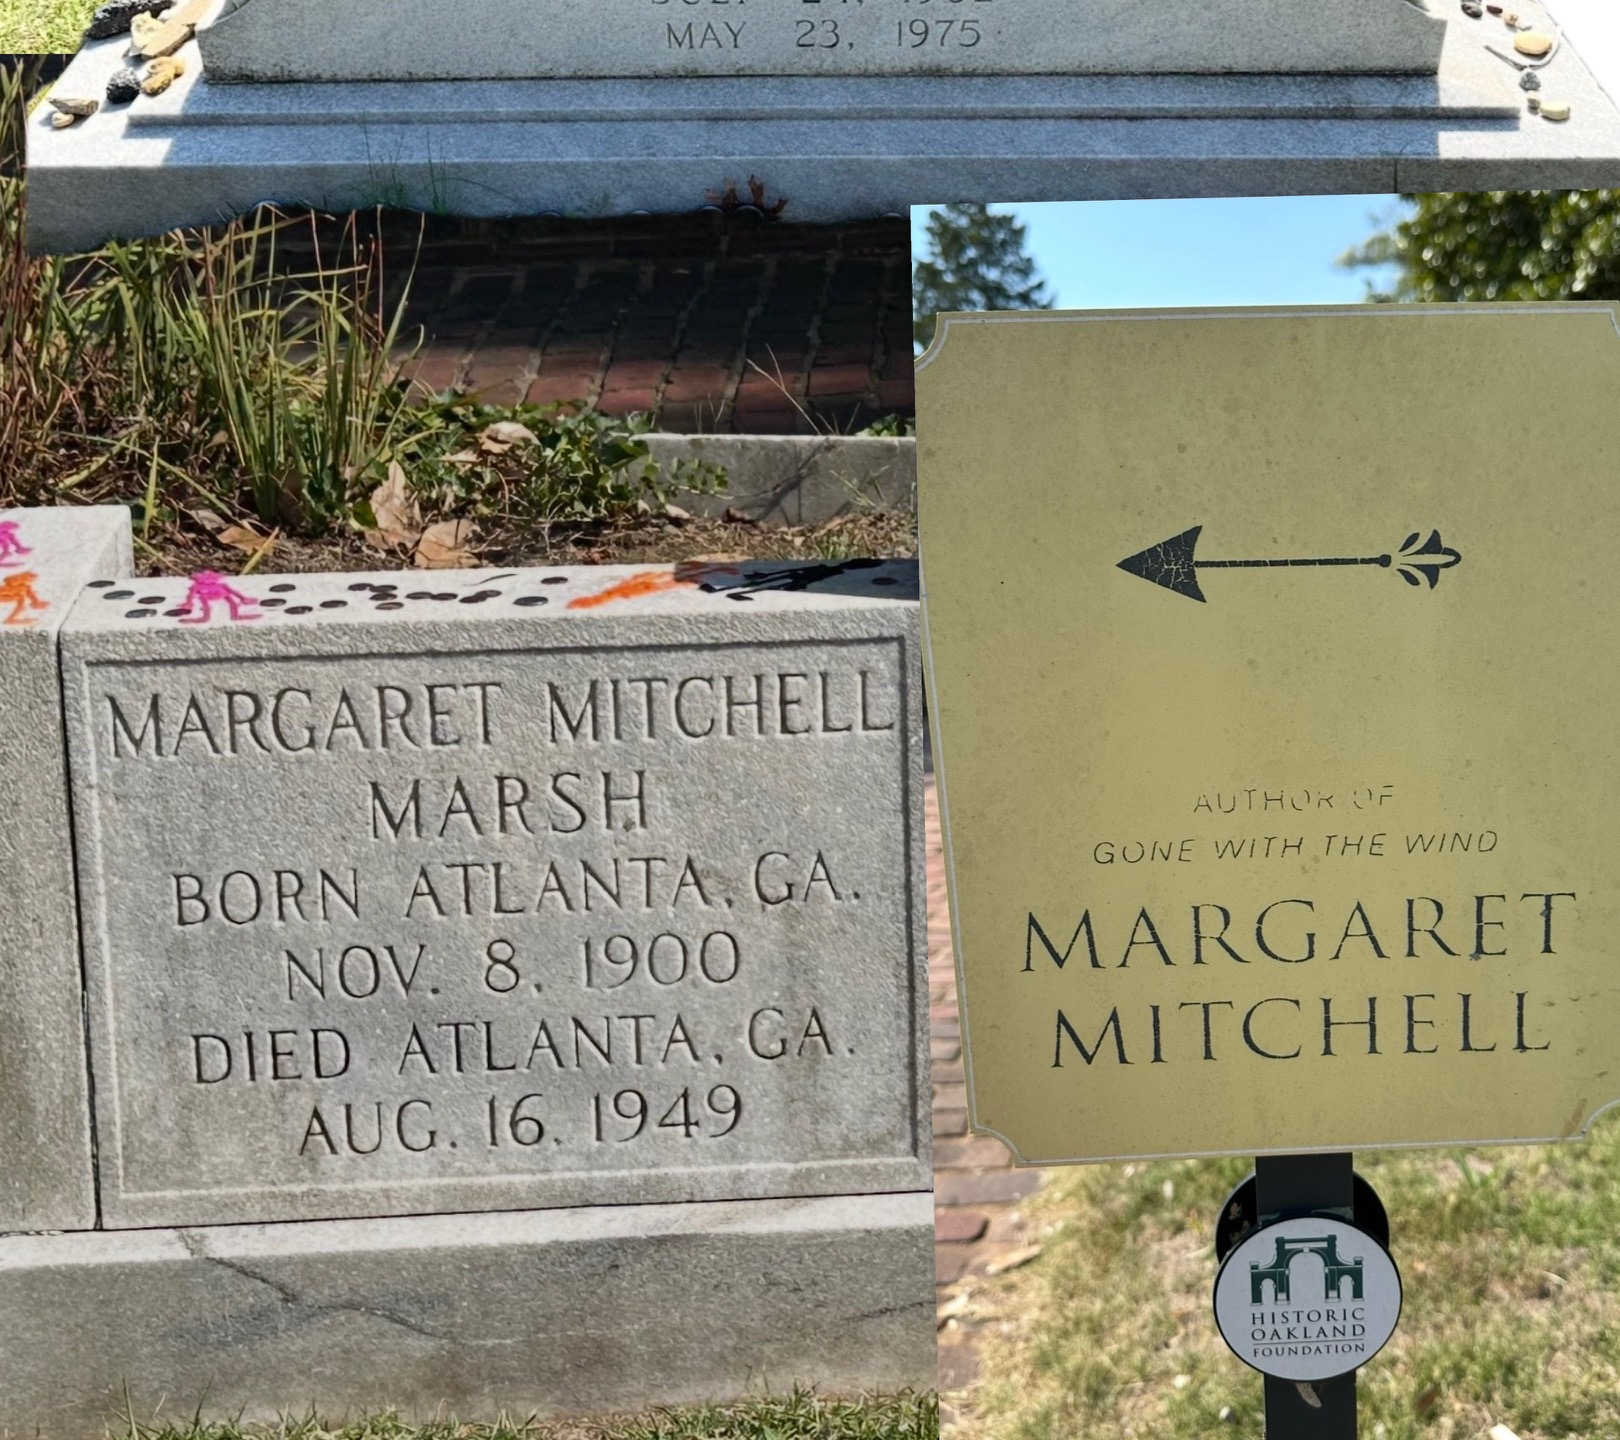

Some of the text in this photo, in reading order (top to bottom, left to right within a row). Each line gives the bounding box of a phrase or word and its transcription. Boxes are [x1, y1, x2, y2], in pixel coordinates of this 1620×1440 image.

[665, 19, 983, 51] MAY 23, 1975
[105, 670, 895, 759] MARGARET MITCHELL
[370, 769, 650, 841] MARSH
[1194, 785, 1394, 813] AUTHOR OF
[1093, 830, 1498, 865] GONE WITH THE WIND
[171, 868, 361, 928] BORN
[754, 849, 862, 908] GA.
[286, 944, 442, 1002] NOV.
[582, 930, 740, 989] 1900
[1020, 892, 1576, 972] MARGARET
[191, 1029, 351, 1085] DIED
[748, 1006, 857, 1062] GA.
[1051, 991, 1551, 1068] MITCHELL
[299, 1099, 459, 1157] AUG.
[593, 1084, 743, 1143] 1949
[1251, 1307, 1365, 1326] HISTORIC
[1251, 1323, 1366, 1342] OAKLAND
[1253, 1342, 1366, 1358] FOUNDATION
